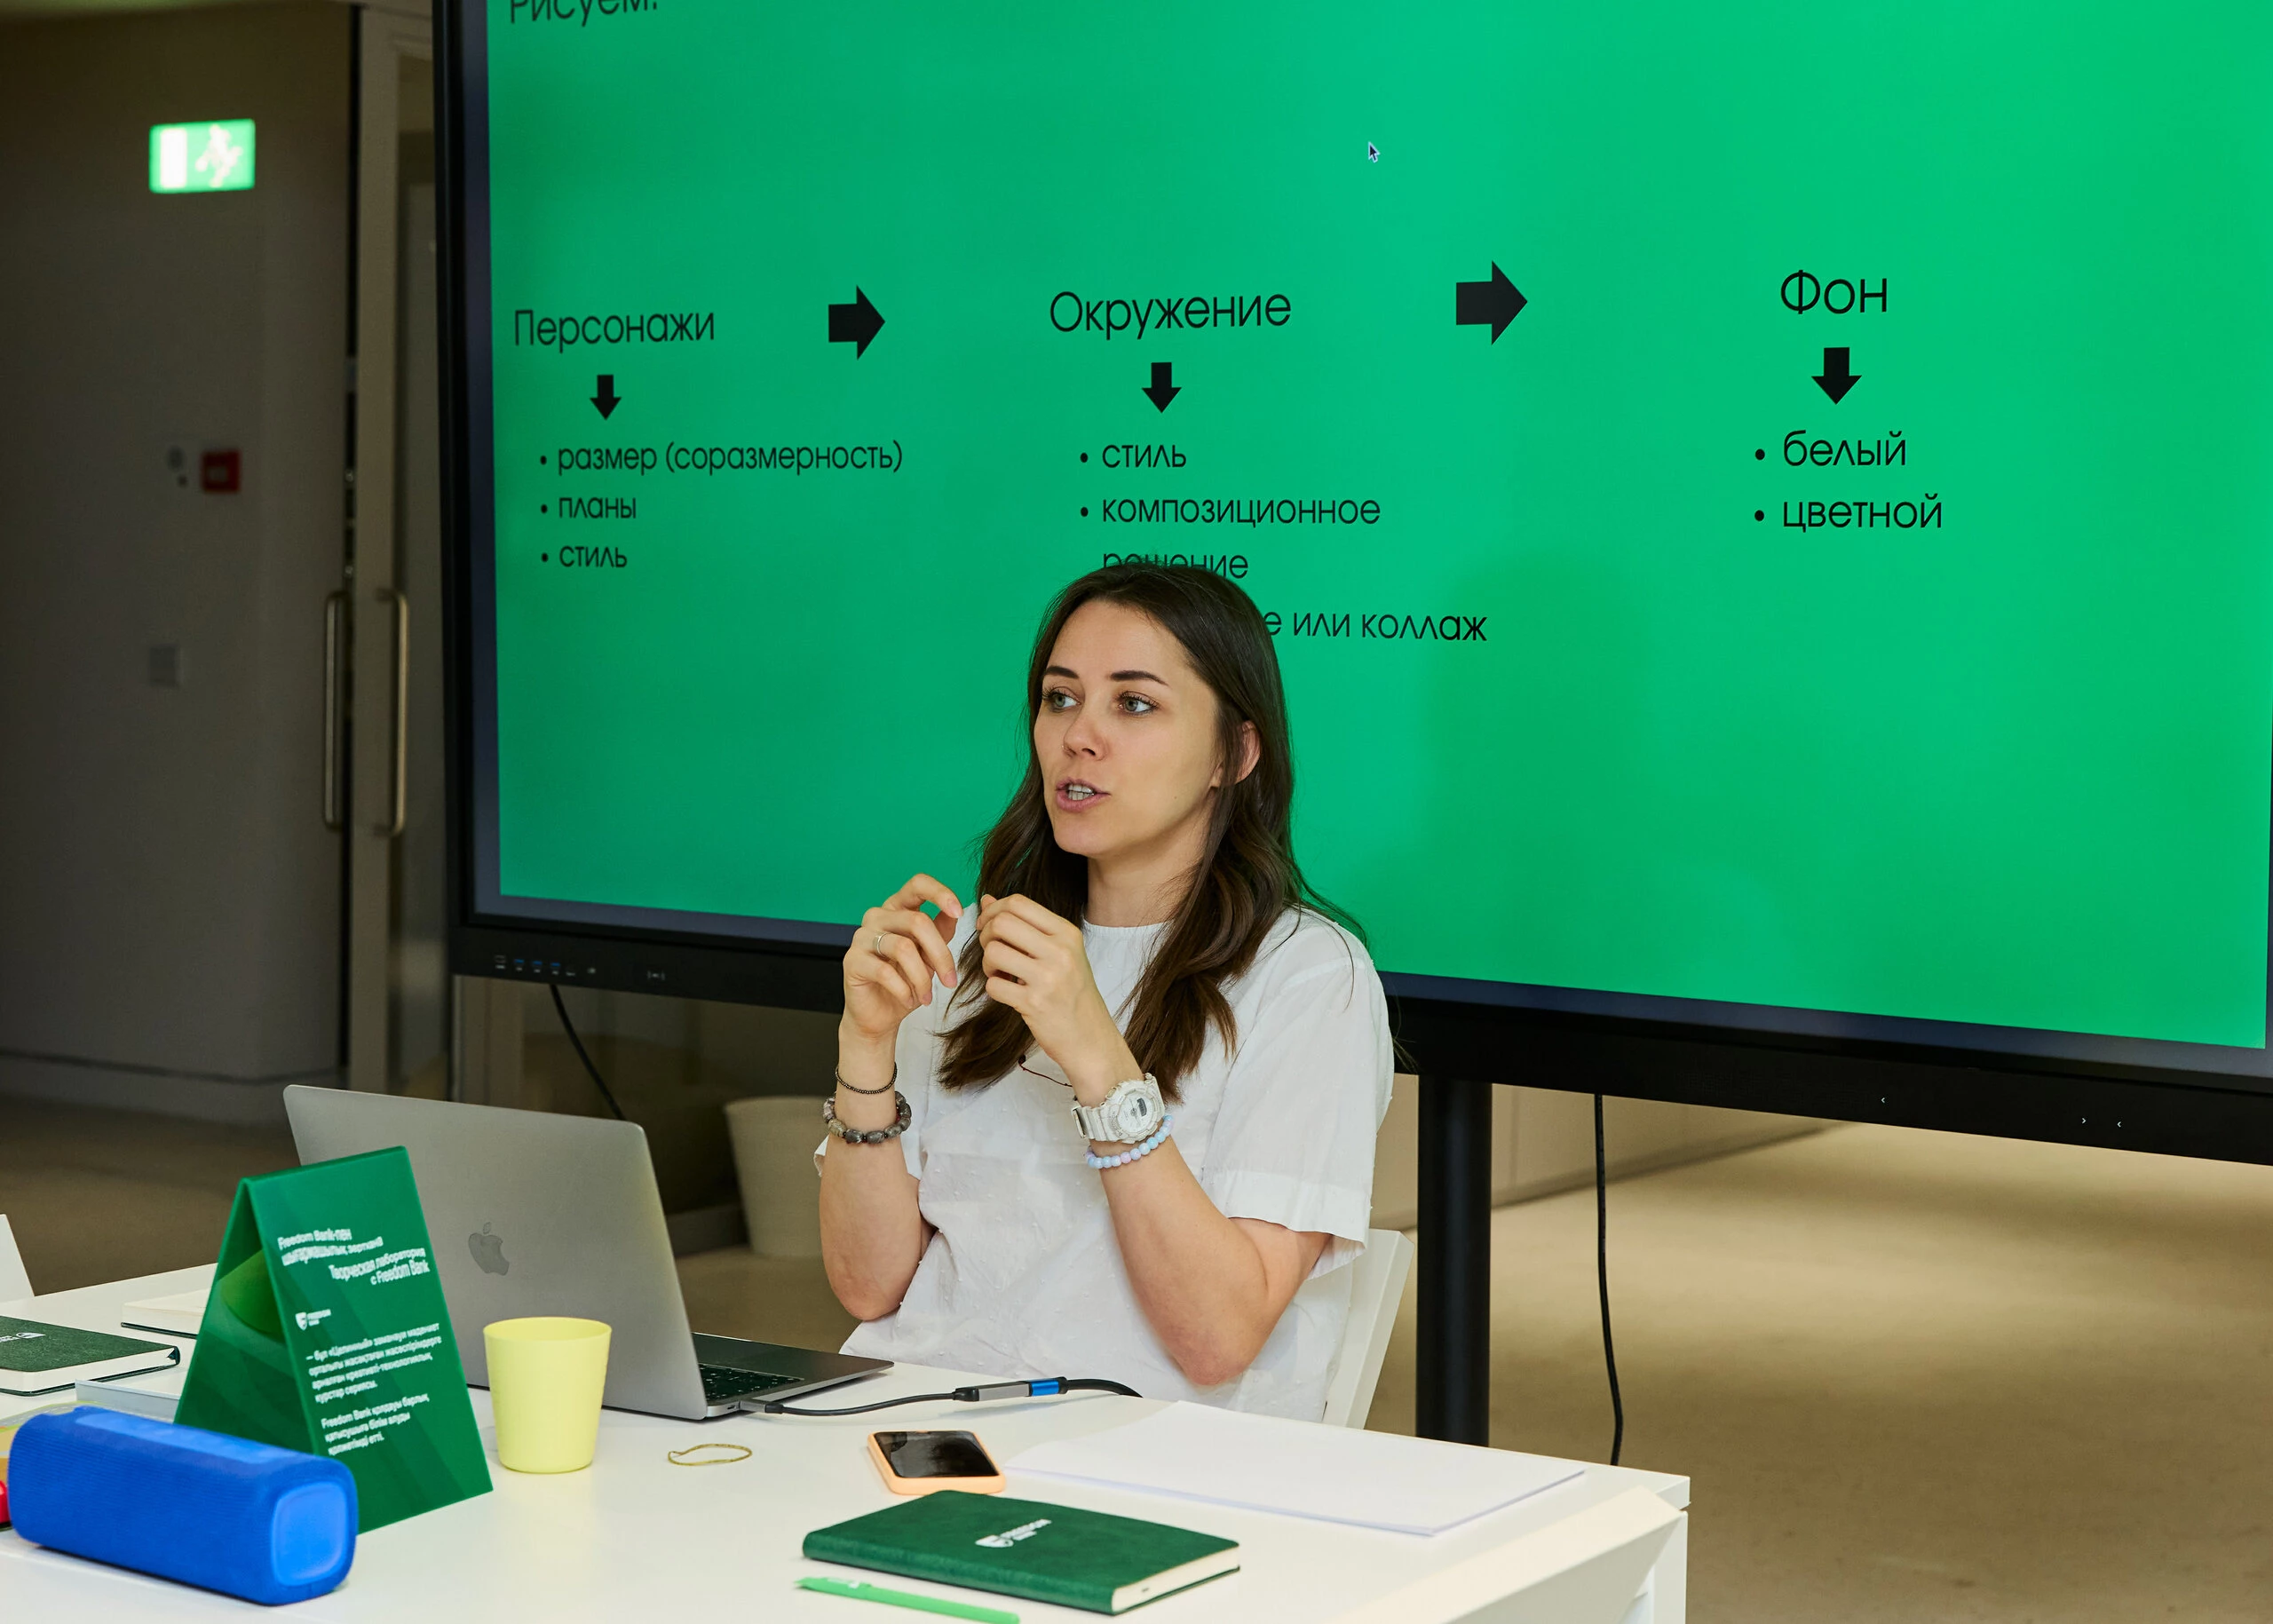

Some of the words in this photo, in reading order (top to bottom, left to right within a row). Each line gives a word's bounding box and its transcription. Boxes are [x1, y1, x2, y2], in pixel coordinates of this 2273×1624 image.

[1780, 269, 1889, 315] Фон
[514, 309, 716, 353] Персонажи
[1049, 290, 1292, 341] Окружение
[558, 448, 657, 476] размер
[665, 440, 903, 476] (соразмерность)
[1102, 444, 1187, 469] стиль
[1783, 429, 1907, 467] белый
[558, 496, 637, 519] планы
[1103, 498, 1381, 528] композиционное
[1783, 493, 1942, 534] цветной
[559, 545, 628, 569] стиль
[1293, 612, 1350, 638] или
[1362, 614, 1488, 642] коллаж
